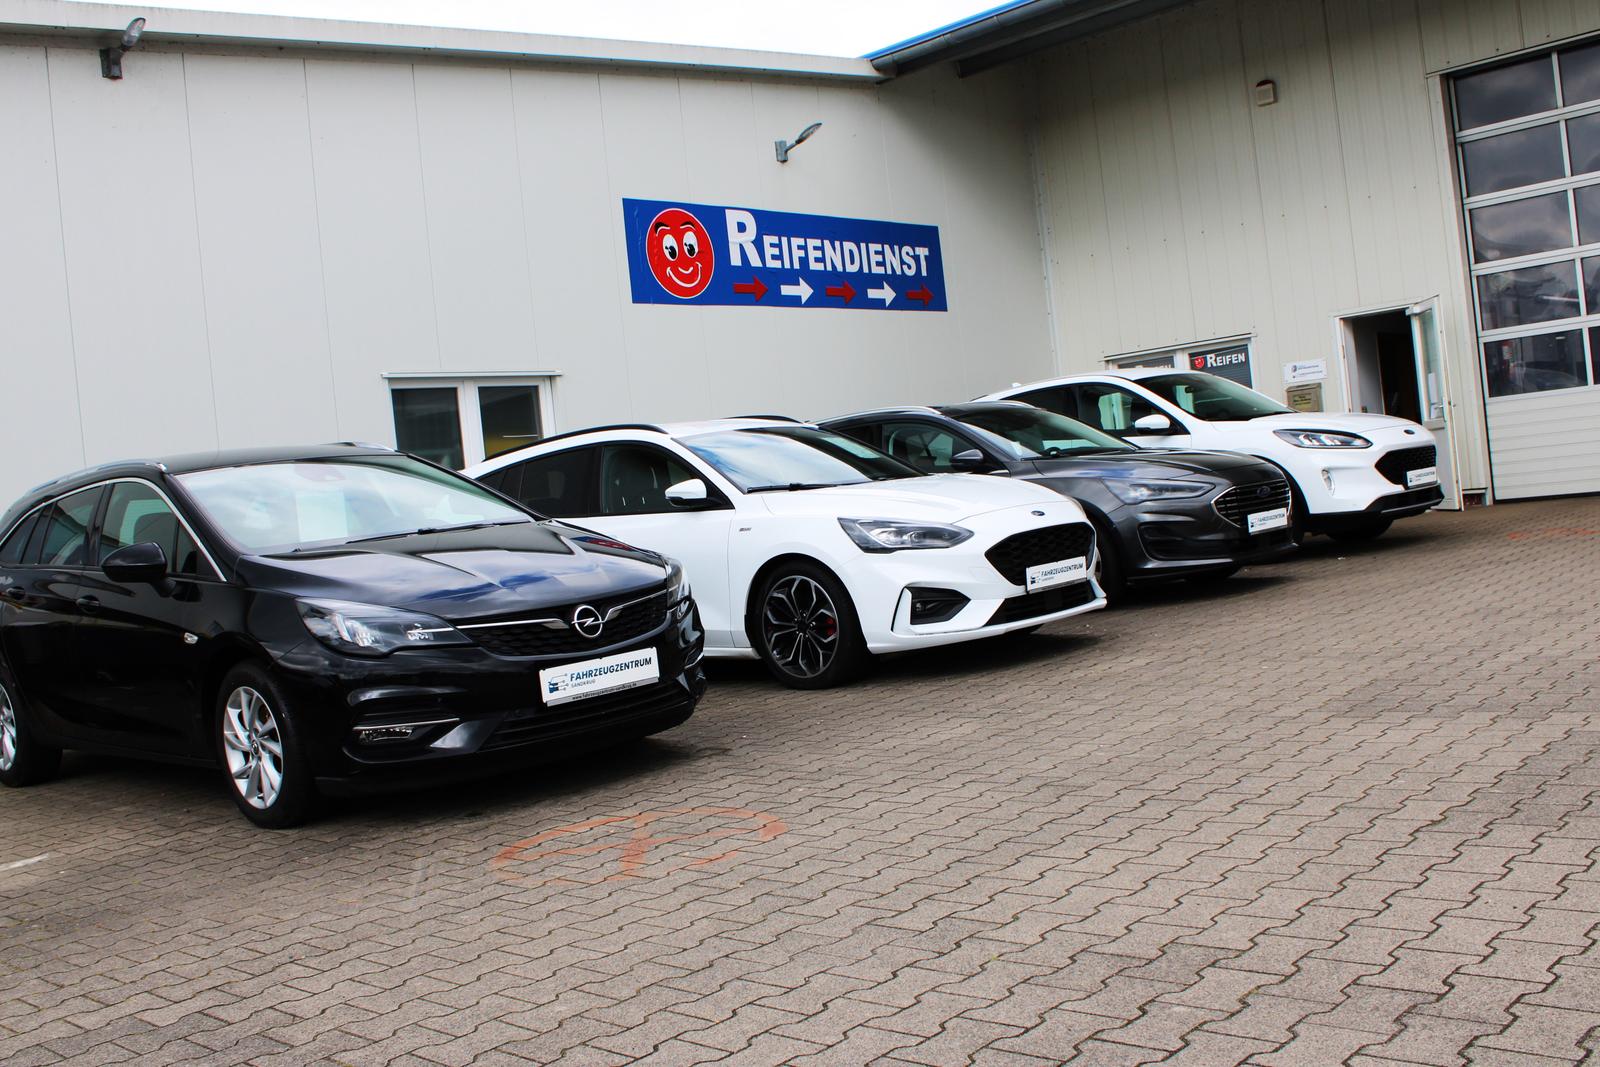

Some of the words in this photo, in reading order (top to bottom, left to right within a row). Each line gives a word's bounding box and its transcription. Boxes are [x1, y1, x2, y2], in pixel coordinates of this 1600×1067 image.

[725, 209, 929, 276] REIFENDIENST
[1206, 353, 1246, 368] REIFEN
[570, 657, 652, 681] FAHRZEUGZENTRUM
